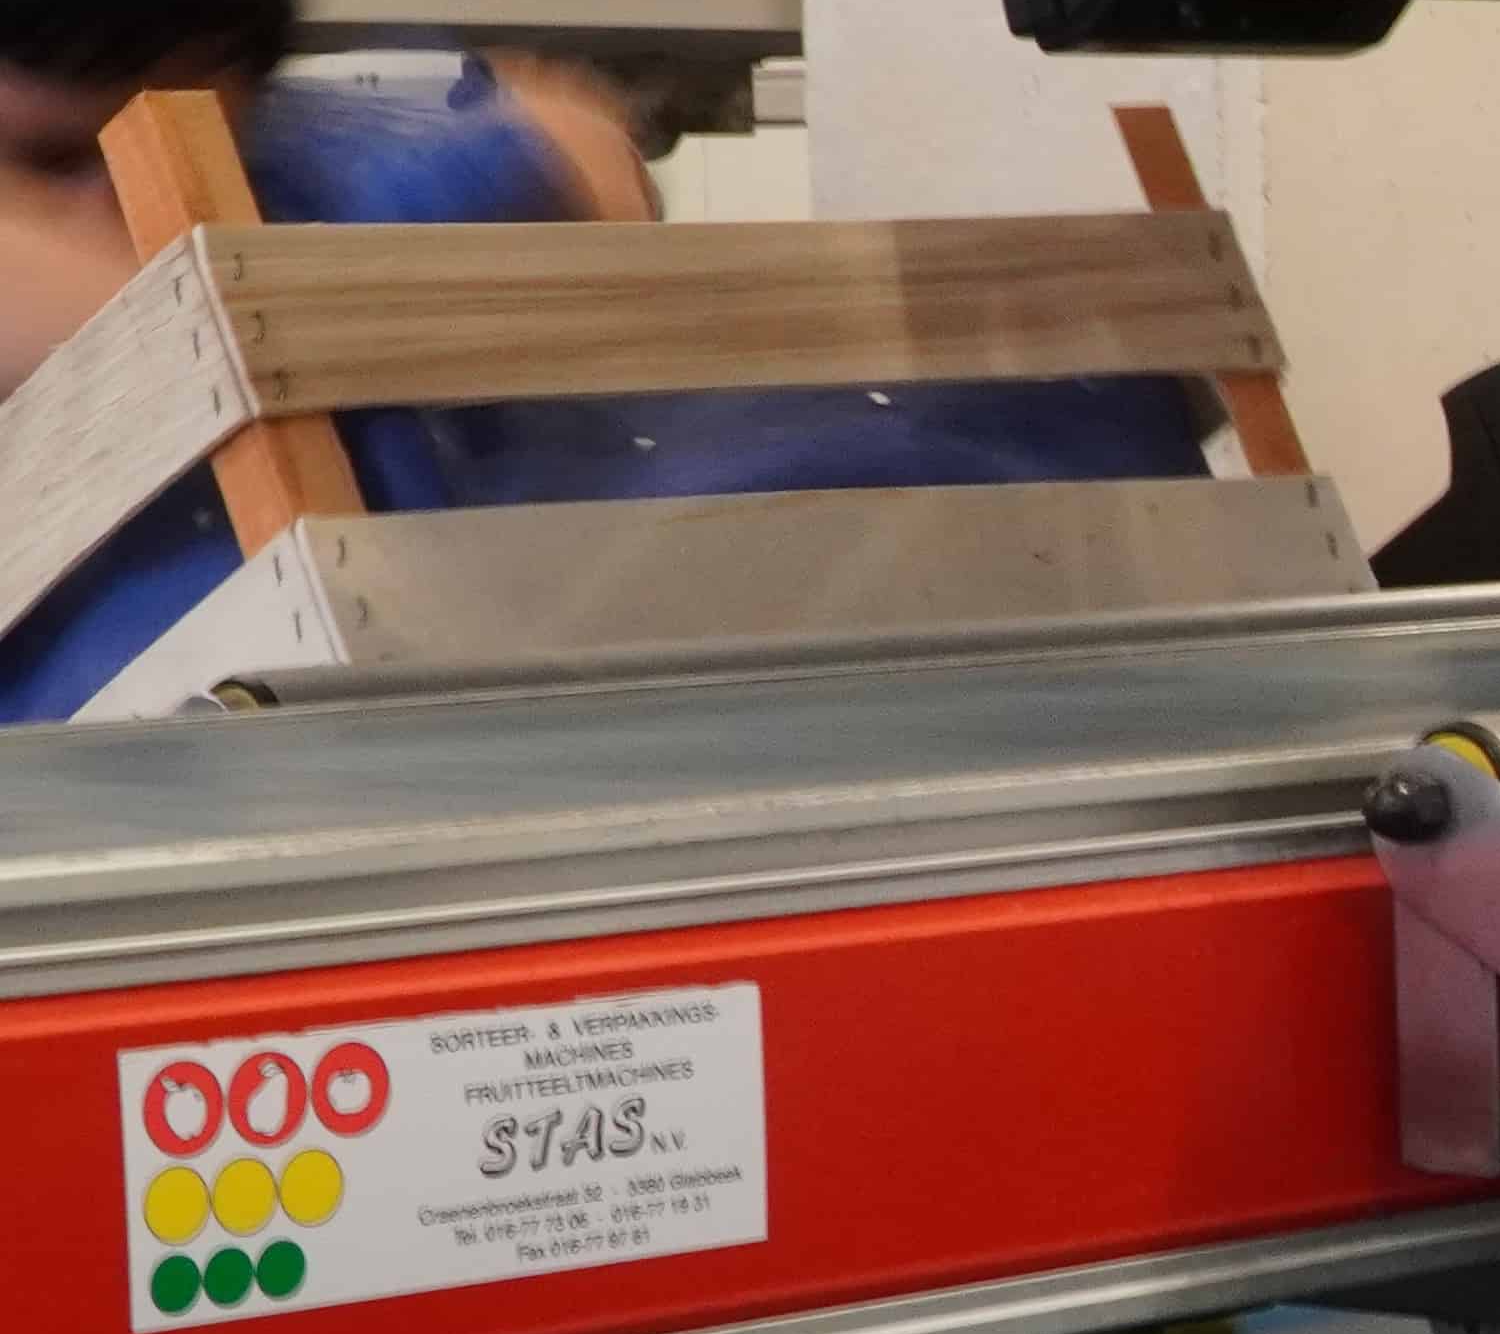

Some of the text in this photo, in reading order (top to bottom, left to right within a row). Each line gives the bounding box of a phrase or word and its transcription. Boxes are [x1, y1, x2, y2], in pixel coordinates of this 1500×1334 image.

[547, 1021, 561, 1042] &
[523, 1041, 634, 1071] MACHINES
[464, 1059, 695, 1106] FRUITTEELTMACHINES
[479, 1097, 646, 1179] STAS
